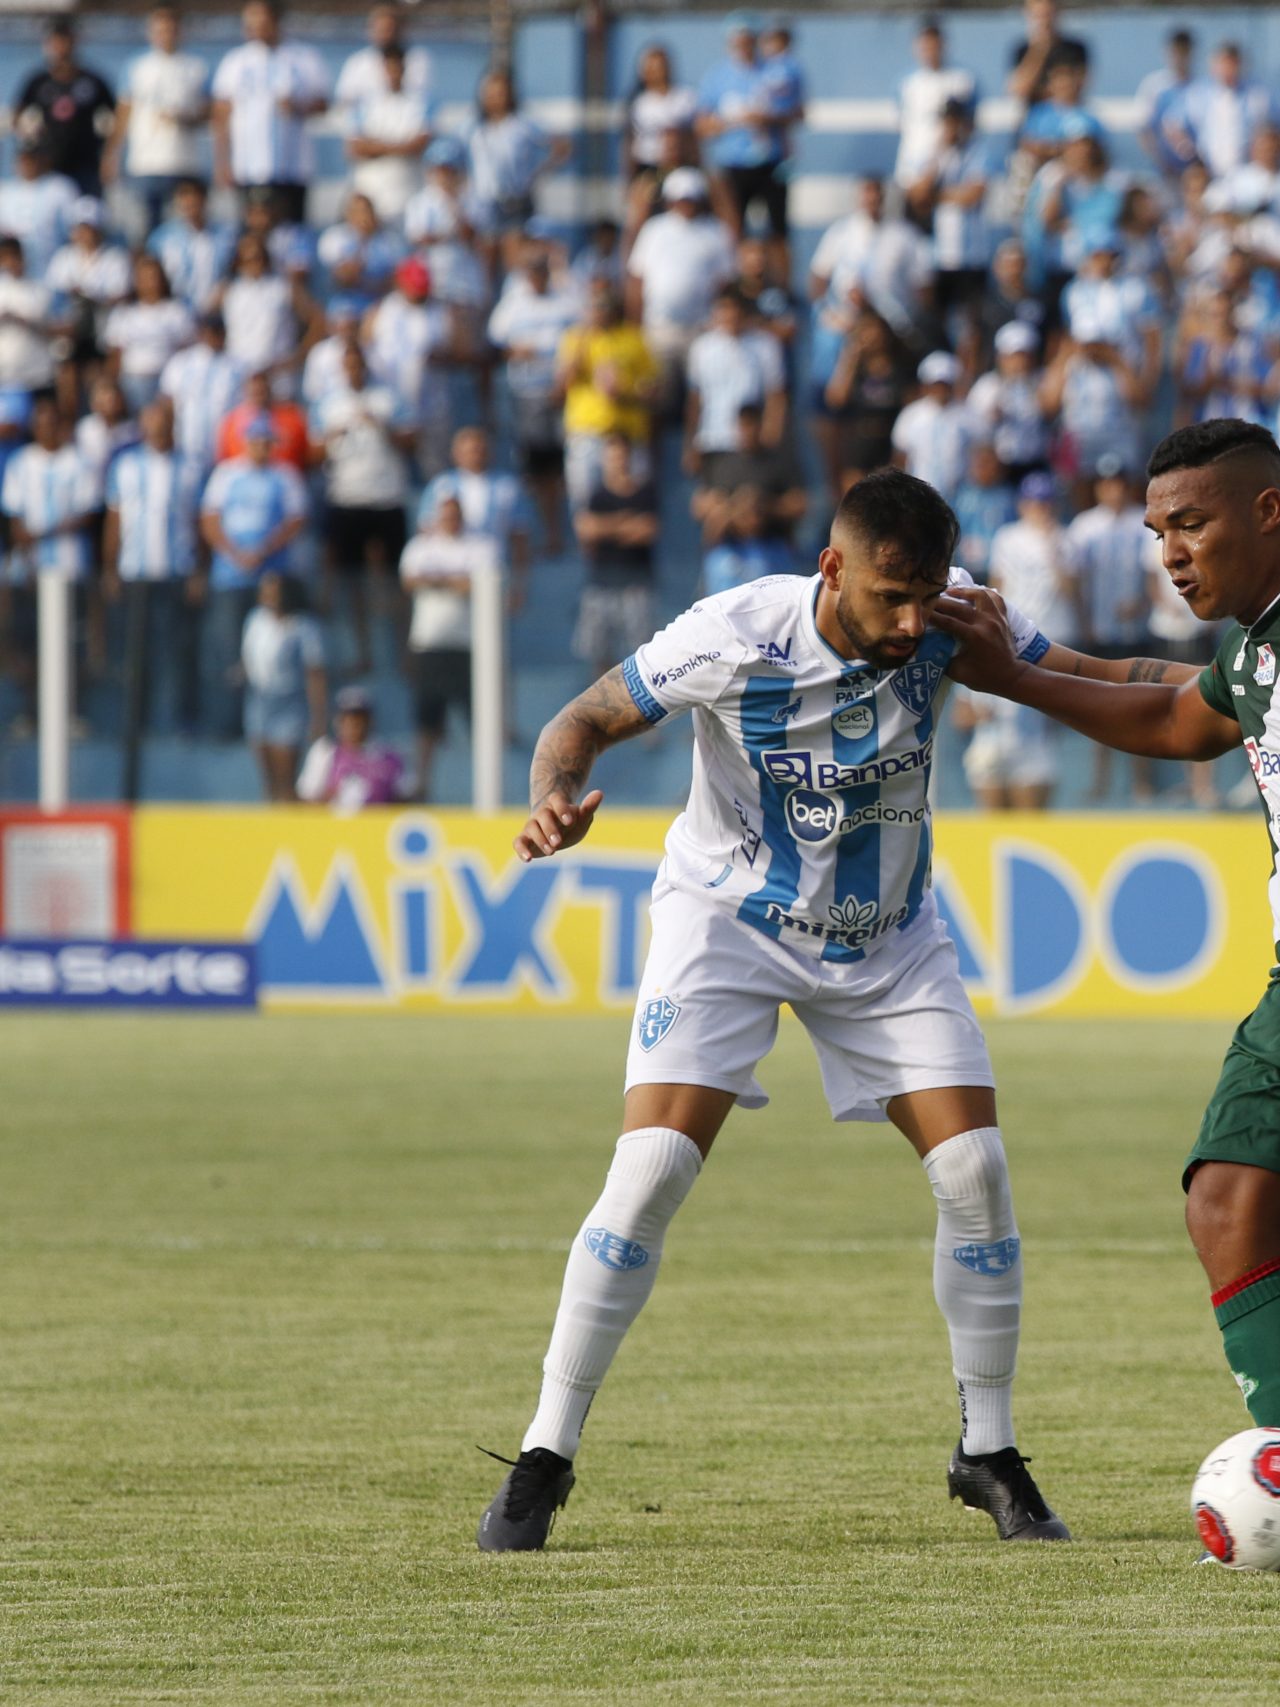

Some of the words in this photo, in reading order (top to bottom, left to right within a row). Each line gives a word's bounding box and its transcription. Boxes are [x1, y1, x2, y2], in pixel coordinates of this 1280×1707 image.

[667, 650, 721, 681] Sankhya
[792, 796, 837, 832] bet
[770, 905, 908, 948] mirella
[58, 946, 250, 996] Sorte
